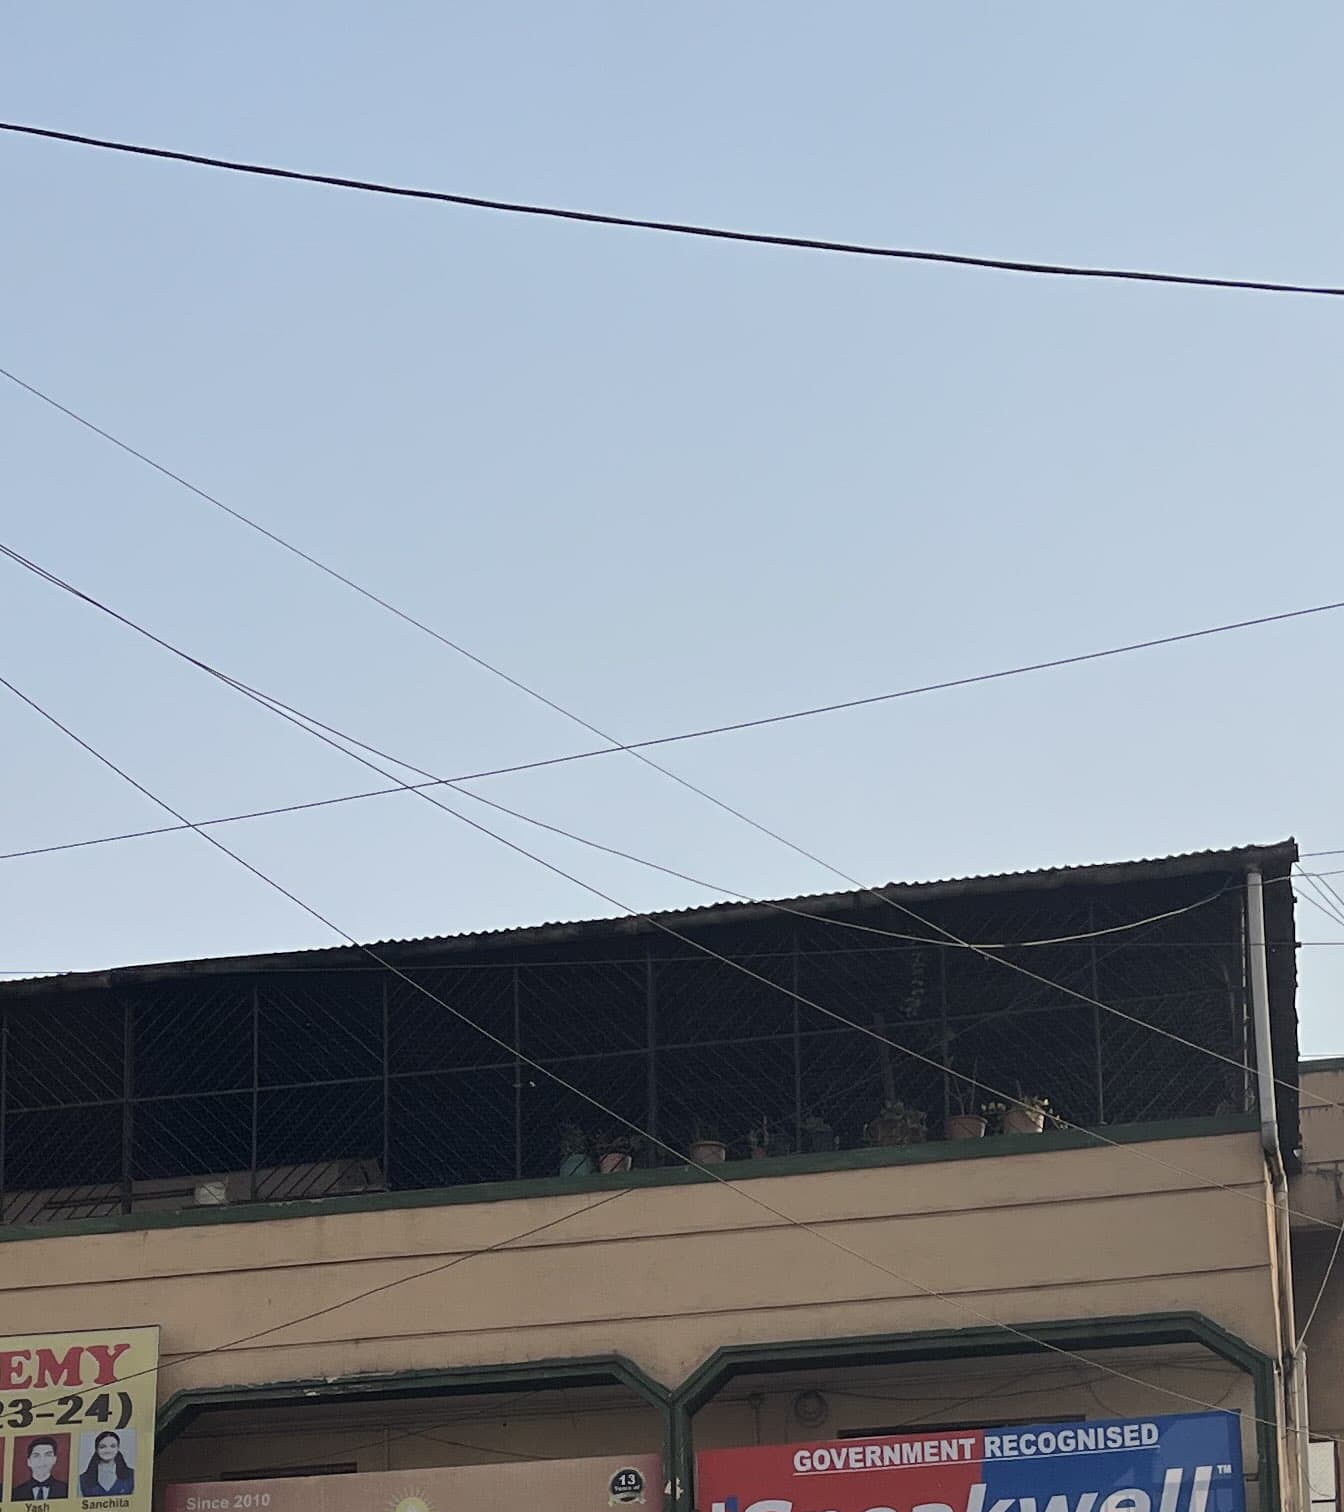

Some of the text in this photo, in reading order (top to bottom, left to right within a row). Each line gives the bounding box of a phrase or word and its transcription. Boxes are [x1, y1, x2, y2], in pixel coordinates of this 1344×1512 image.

[793, 1423, 1159, 1473] GOVERNMENT RECOGNISED
[619, 1473, 637, 1486] 13
[25, 1502, 50, 1512] Yash
[81, 1498, 129, 1510] Sanchita
[186, 1493, 271, 1511] Since 2010
